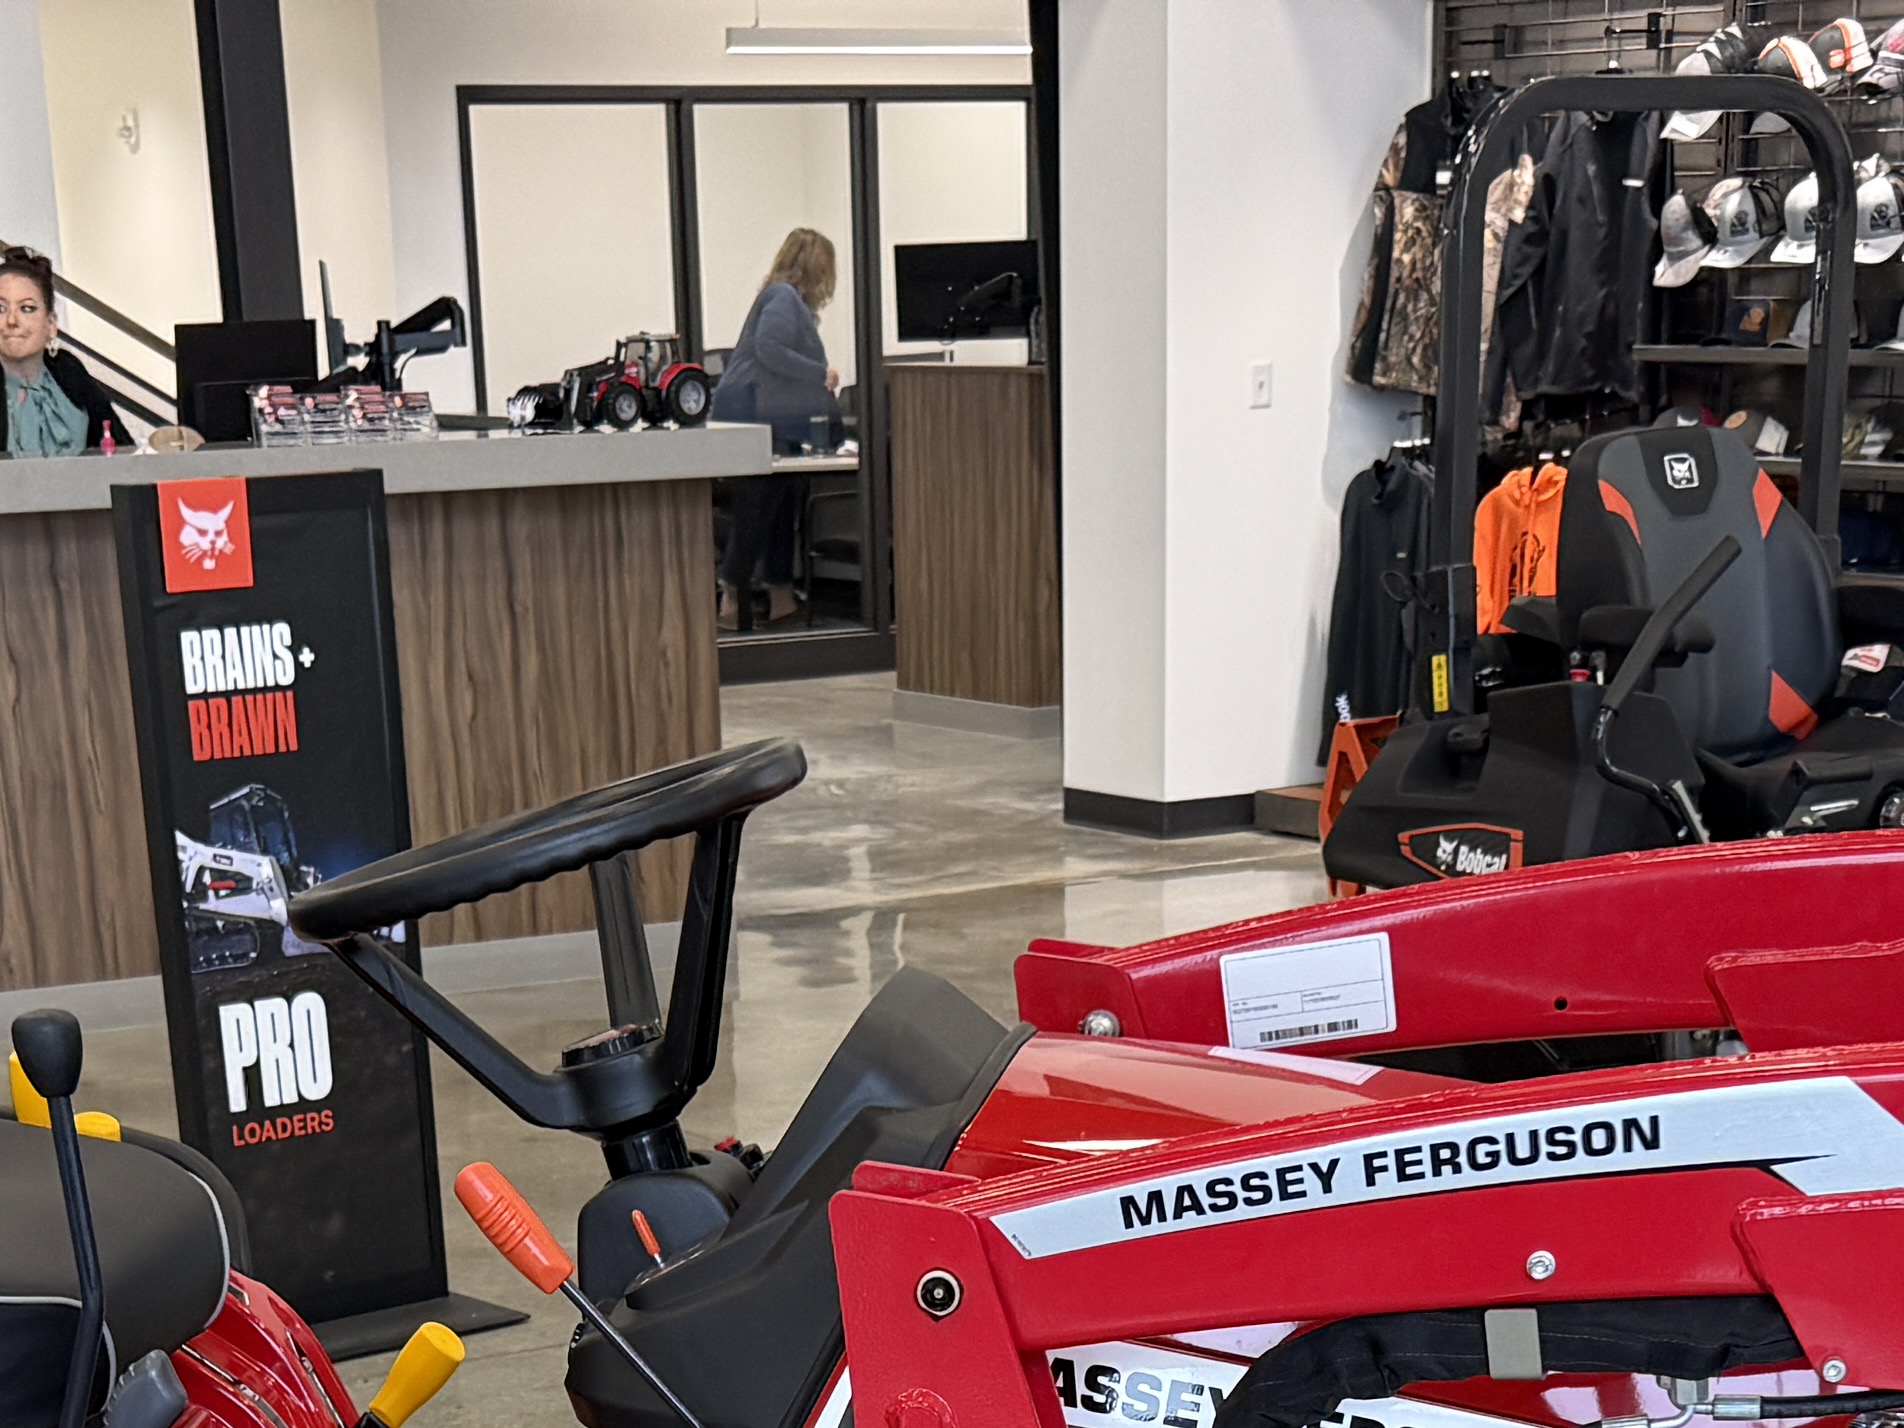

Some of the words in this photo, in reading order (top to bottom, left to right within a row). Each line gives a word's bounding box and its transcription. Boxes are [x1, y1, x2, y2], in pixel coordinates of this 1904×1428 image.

[187, 690, 298, 761] BRAWN
[1456, 845, 1507, 874] Bobcat
[218, 991, 333, 1114] PRO
[232, 1109, 334, 1147] LOADERS
[1119, 1157, 1341, 1230] MASSEY
[1363, 1114, 1661, 1189] FERGUSON
